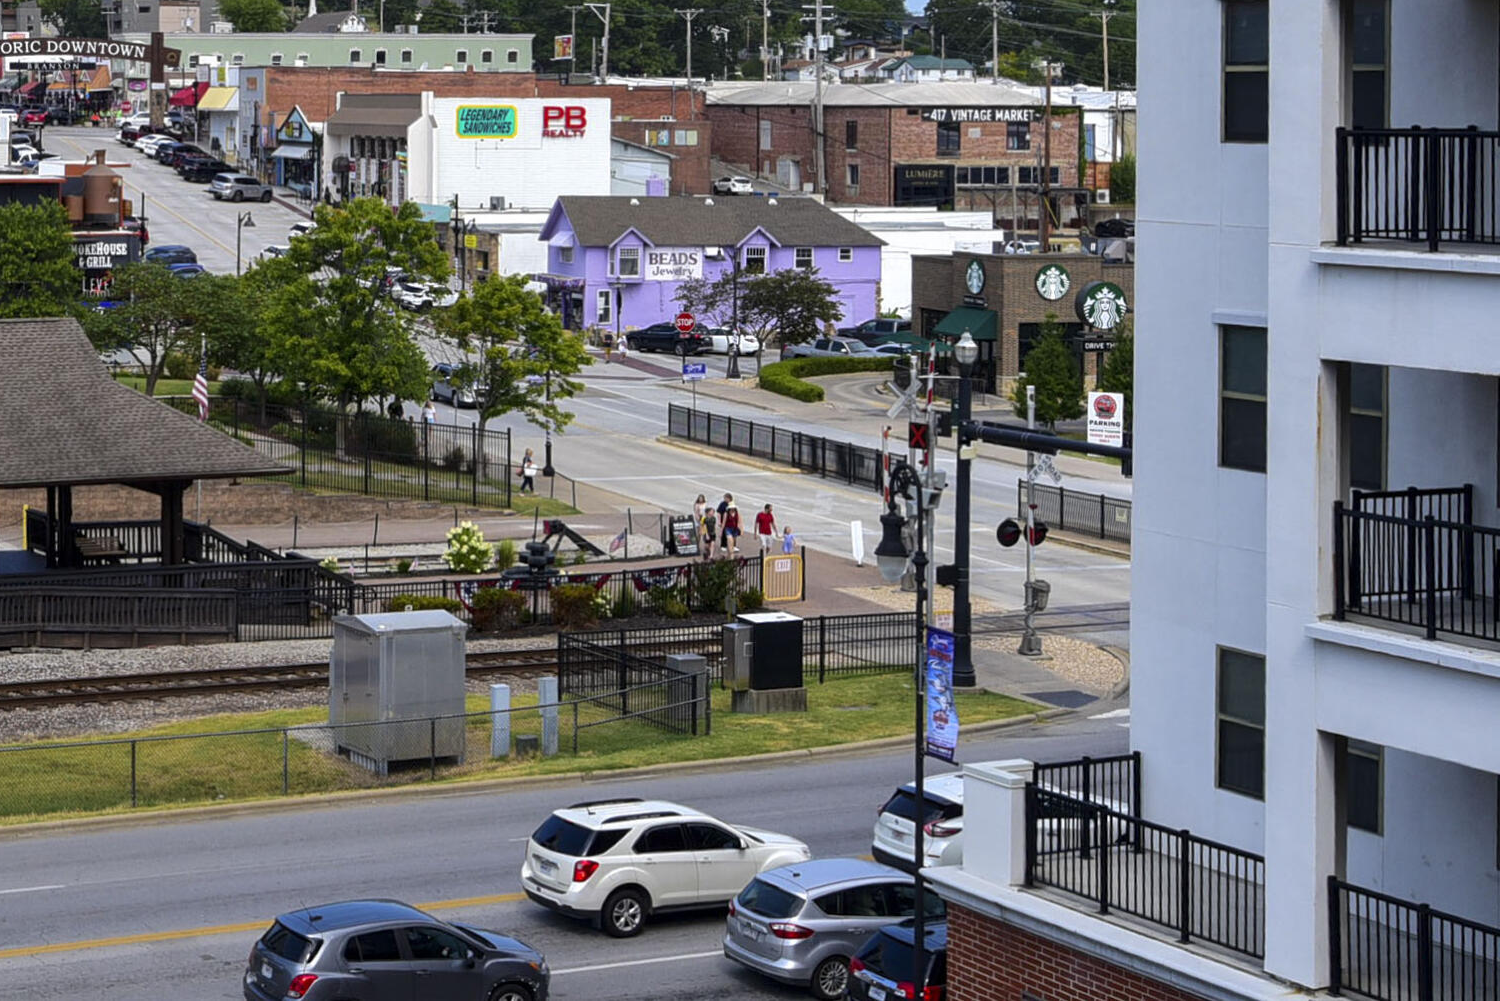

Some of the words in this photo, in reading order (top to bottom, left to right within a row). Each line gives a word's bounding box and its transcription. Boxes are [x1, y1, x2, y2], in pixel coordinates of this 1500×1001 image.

[47, 40, 146, 58] DOWNTOWN
[27, 62, 80, 70] BRANSON
[460, 109, 509, 121] LEGENDARY
[543, 105, 587, 130] PB
[930, 109, 947, 120] 417
[950, 109, 992, 121] VINTAGE
[995, 109, 1036, 121] MARKET
[462, 121, 512, 134] SANDWICHES
[542, 129, 586, 138] REALTY
[70, 242, 128, 255] MOKEHOUSE
[86, 256, 113, 268] GRILL
[649, 252, 698, 265] BEADS
[652, 266, 694, 277] Jewelry
[677, 318, 694, 327] STOP
